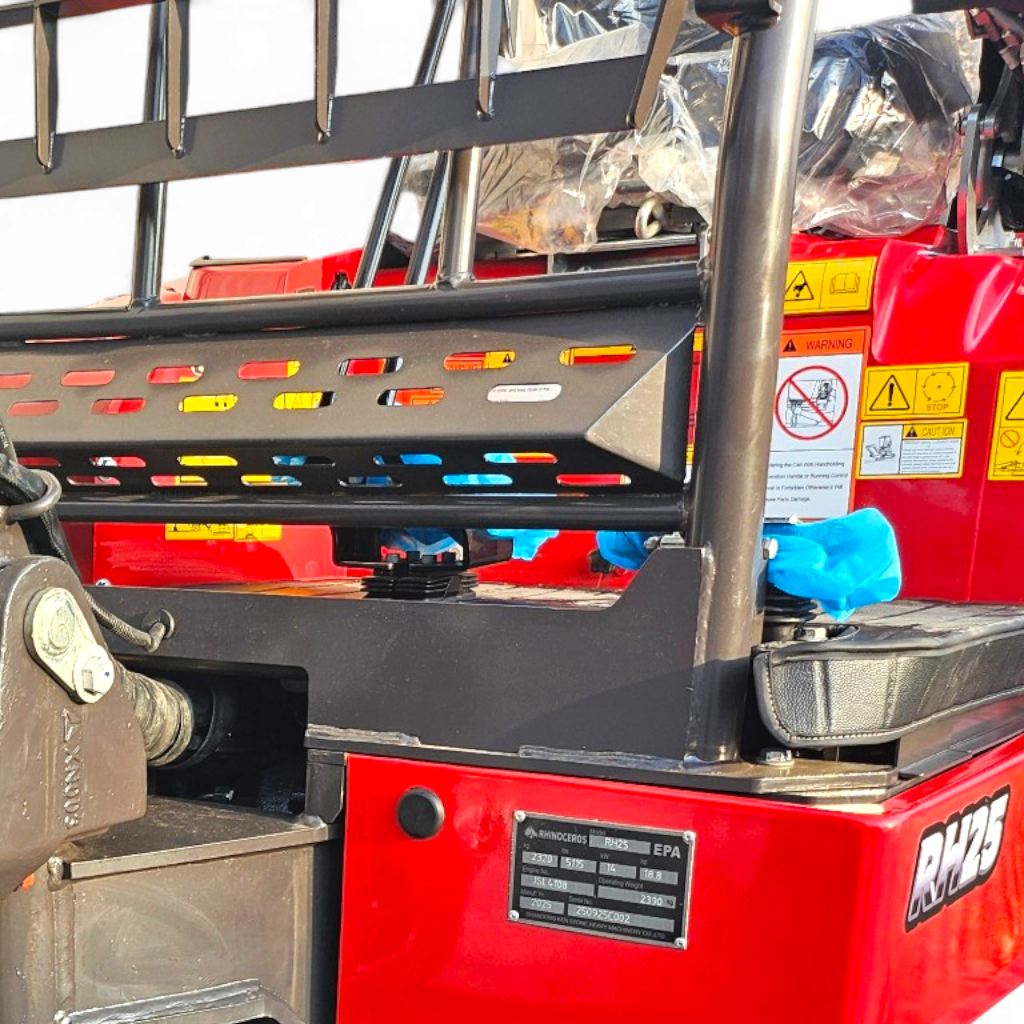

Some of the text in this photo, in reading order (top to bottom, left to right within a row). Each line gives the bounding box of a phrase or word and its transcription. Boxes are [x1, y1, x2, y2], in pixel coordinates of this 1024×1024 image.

[806, 338, 853, 350] WARNING
[921, 426, 955, 437] CAUTION
[538, 830, 681, 859] RHINOCEROS RH25 EPA
[905, 787, 1010, 930] RH25
[531, 853, 553, 864] 2320
[607, 864, 616, 873] 14
[644, 870, 662, 881] 18.8
[598, 877, 624, 888] Operating
[625, 880, 643, 889] Weight
[531, 898, 552, 909] 2025
[640, 895, 663, 906] 2390
